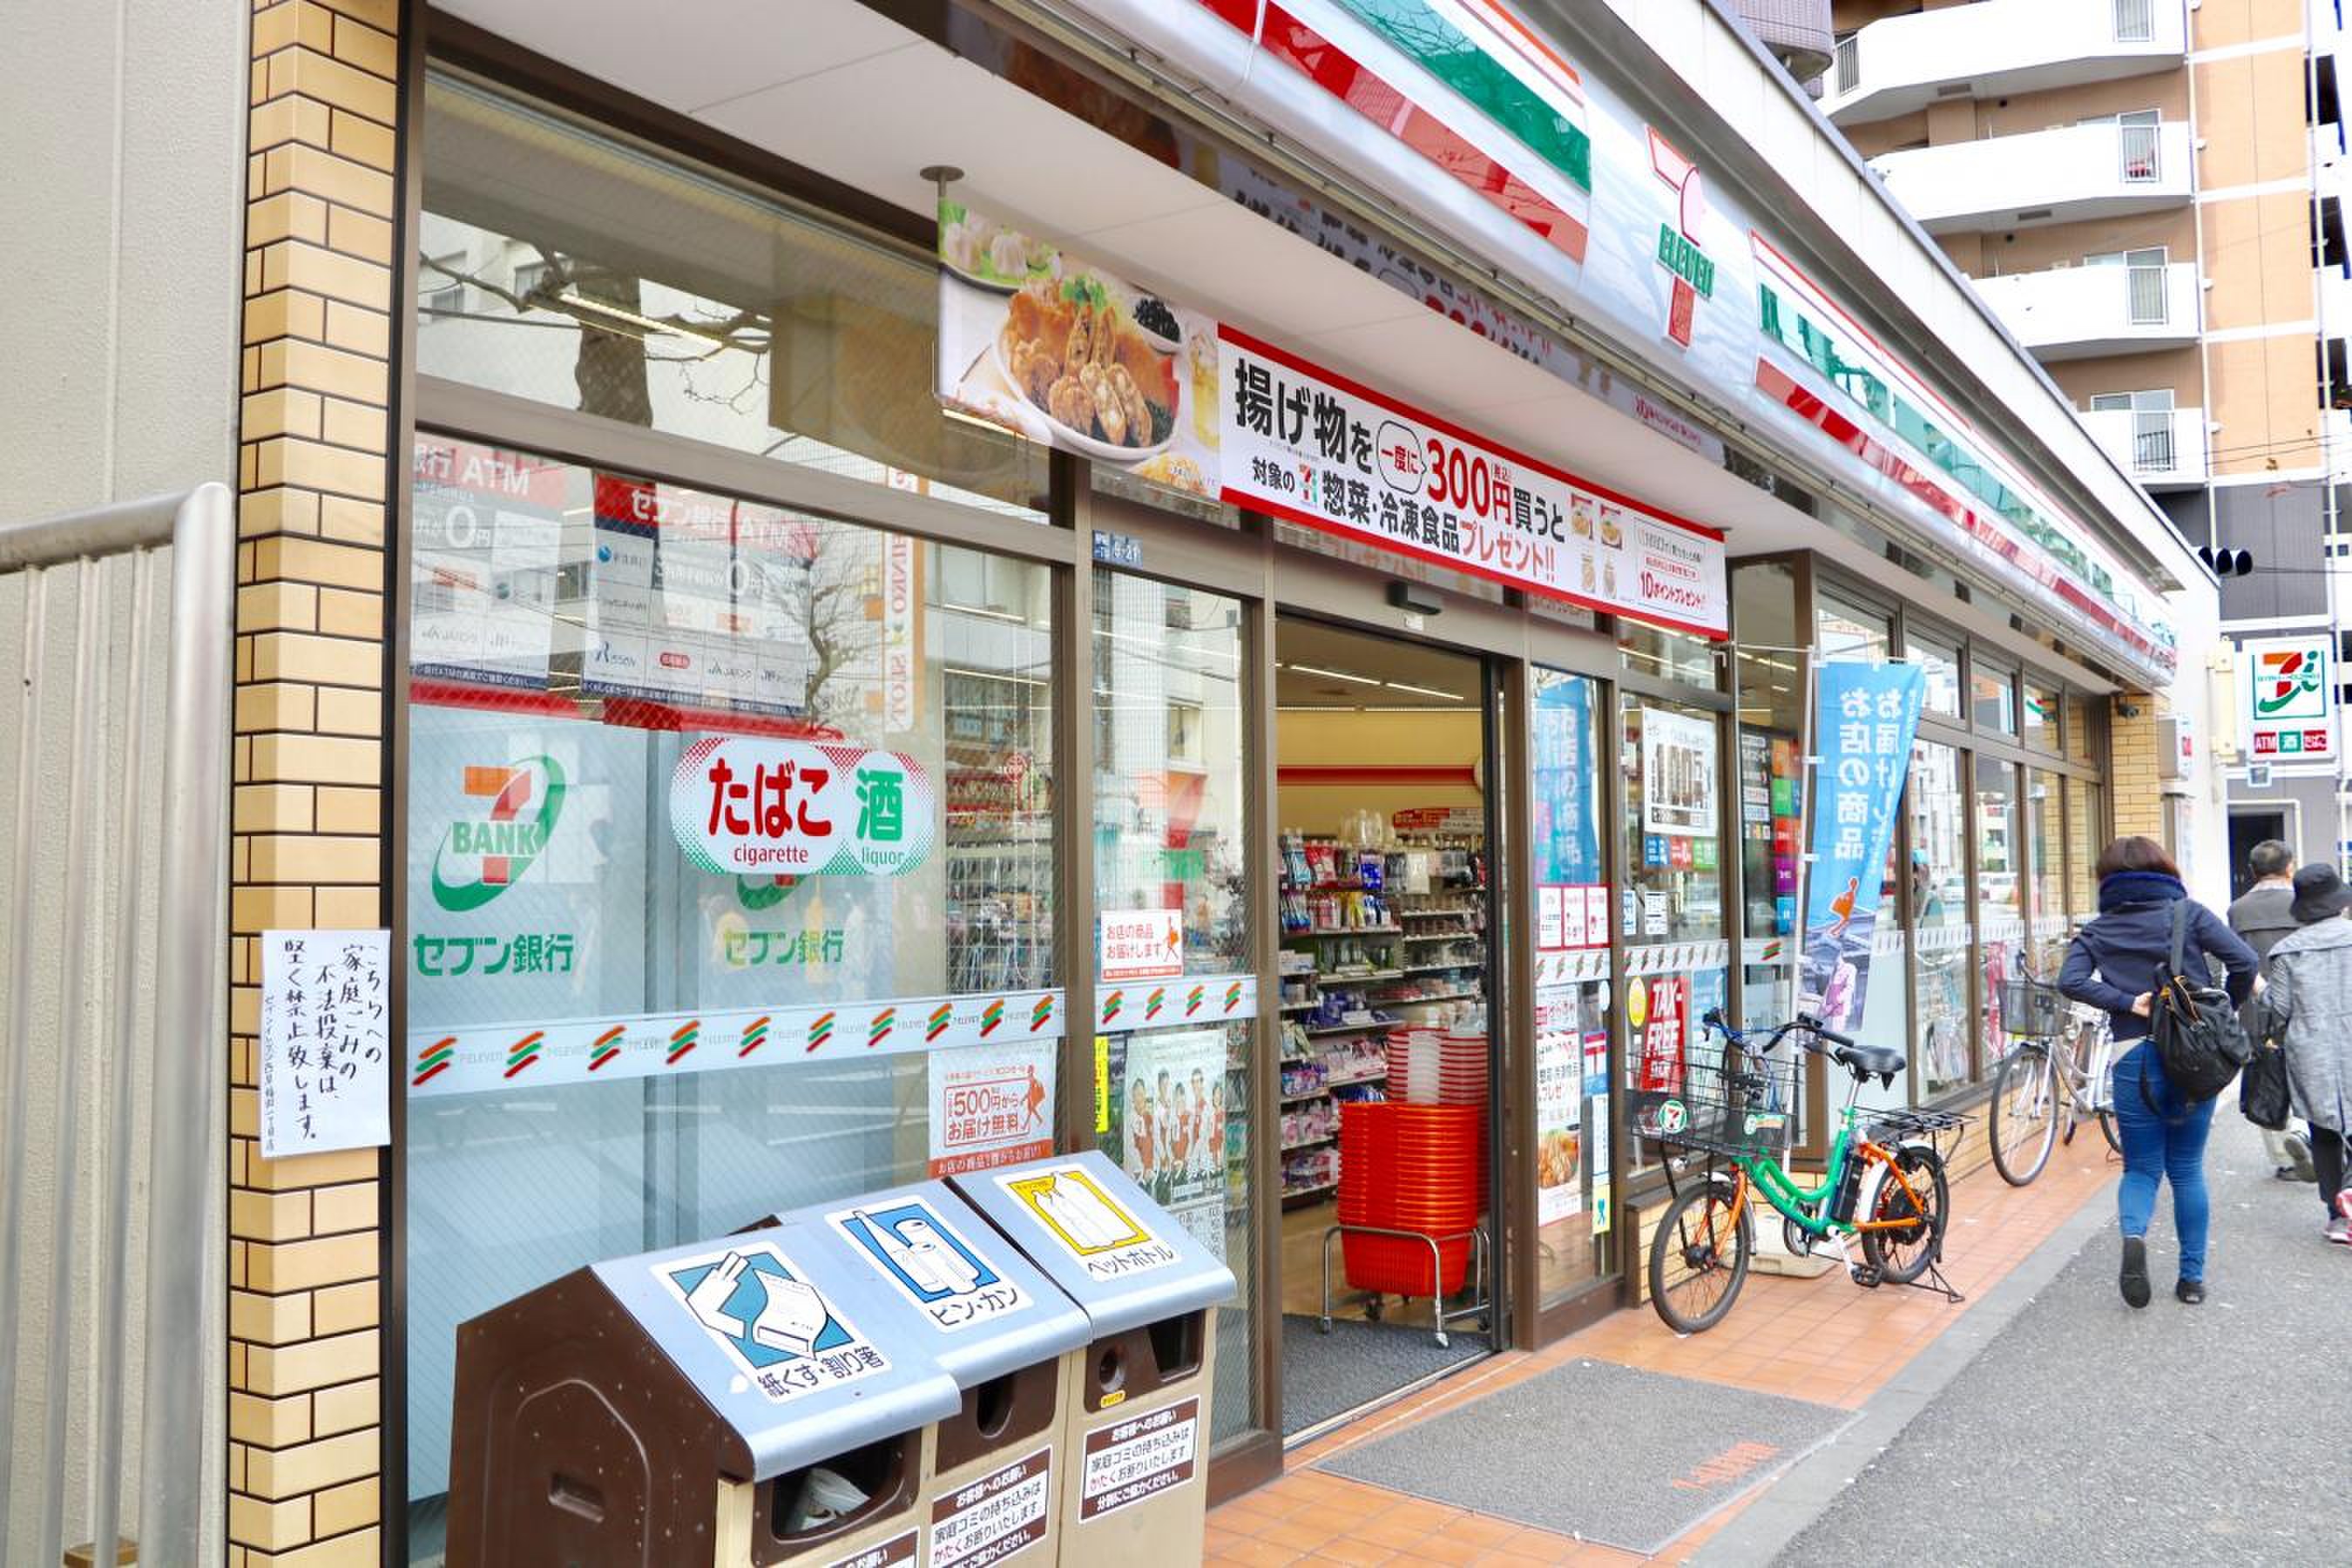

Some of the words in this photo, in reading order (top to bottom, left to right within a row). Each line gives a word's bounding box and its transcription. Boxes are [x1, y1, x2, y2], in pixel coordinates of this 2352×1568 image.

[1235, 358, 1372, 474] 揚げ物を
[1381, 445, 1418, 474] 一度に
[1427, 438, 1565, 543] 300円買うと
[462, 455, 530, 497] ATM
[1253, 456, 1295, 493] 対象の
[708, 758, 832, 838] たばこ
[855, 767, 904, 842] 酒
[451, 821, 537, 855] BANK
[733, 843, 809, 867] cigarette
[862, 846, 904, 868] liquor
[414, 933, 574, 977] セブン銀行
[724, 929, 843, 965] セブン銀行
[339, 944, 363, 1080] 家庭ごみの
[365, 945, 382, 1064] こちらへの
[935, 1481, 1041, 1545] 家庭ゴミの持ち込みは
